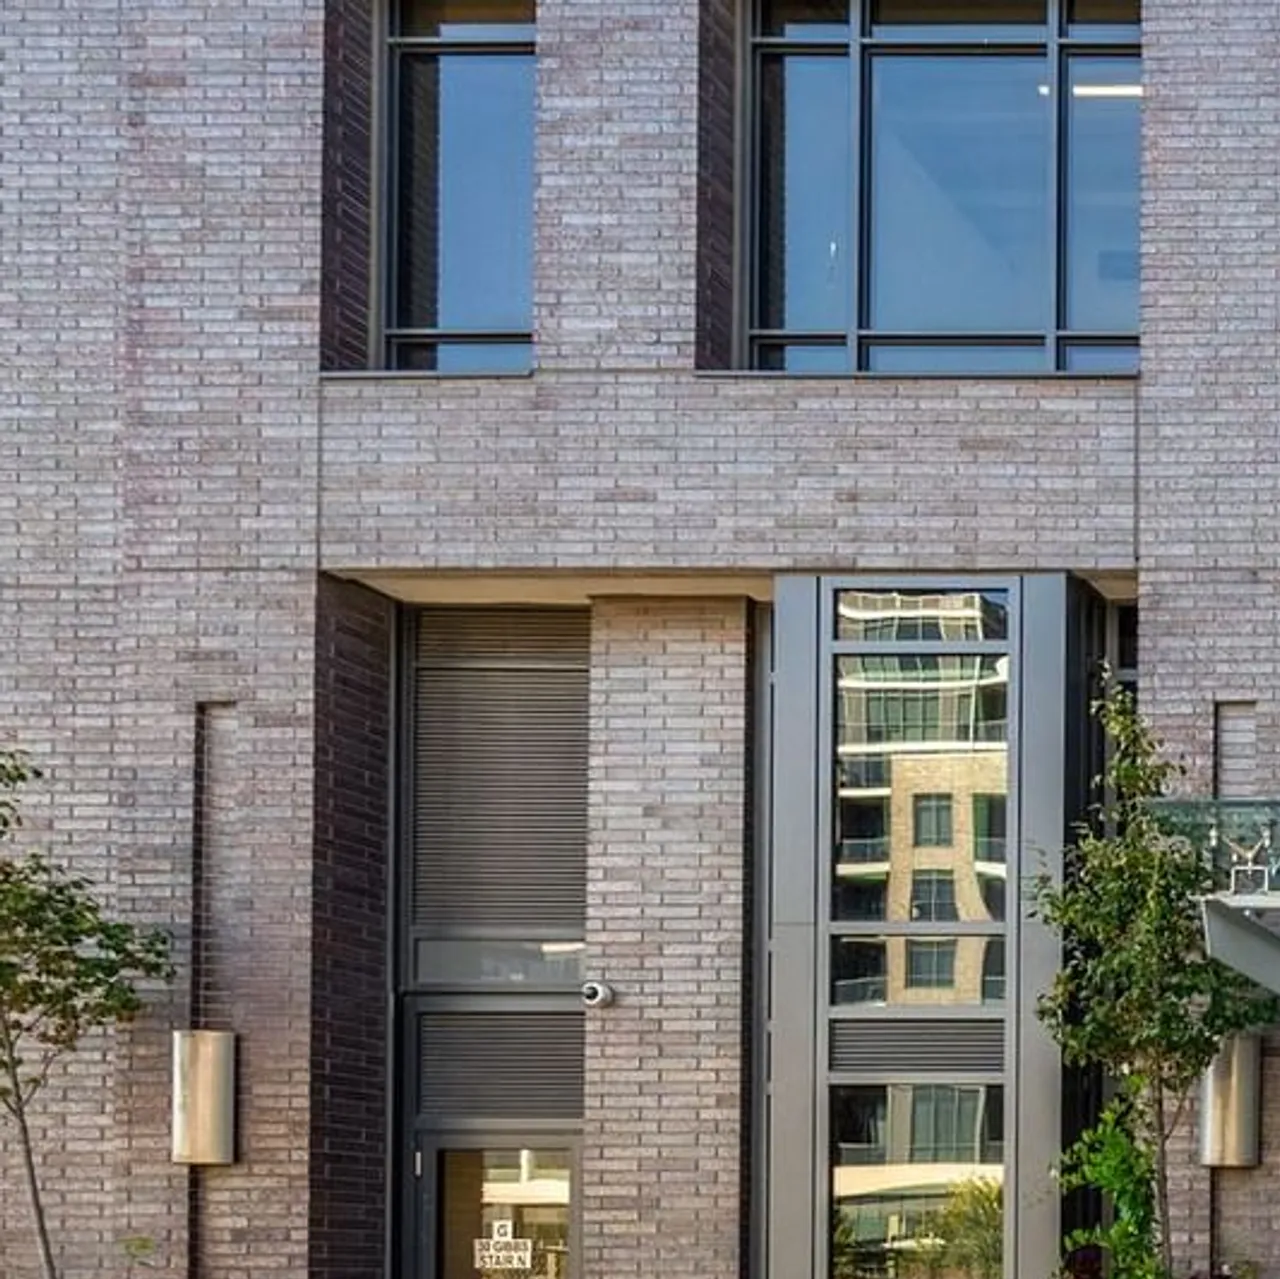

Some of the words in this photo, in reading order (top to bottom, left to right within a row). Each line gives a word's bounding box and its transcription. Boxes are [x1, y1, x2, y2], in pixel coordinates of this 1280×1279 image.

[497, 1223, 508, 1237] G
[480, 1255, 513, 1266] STAIR
[517, 1255, 526, 1266] N
